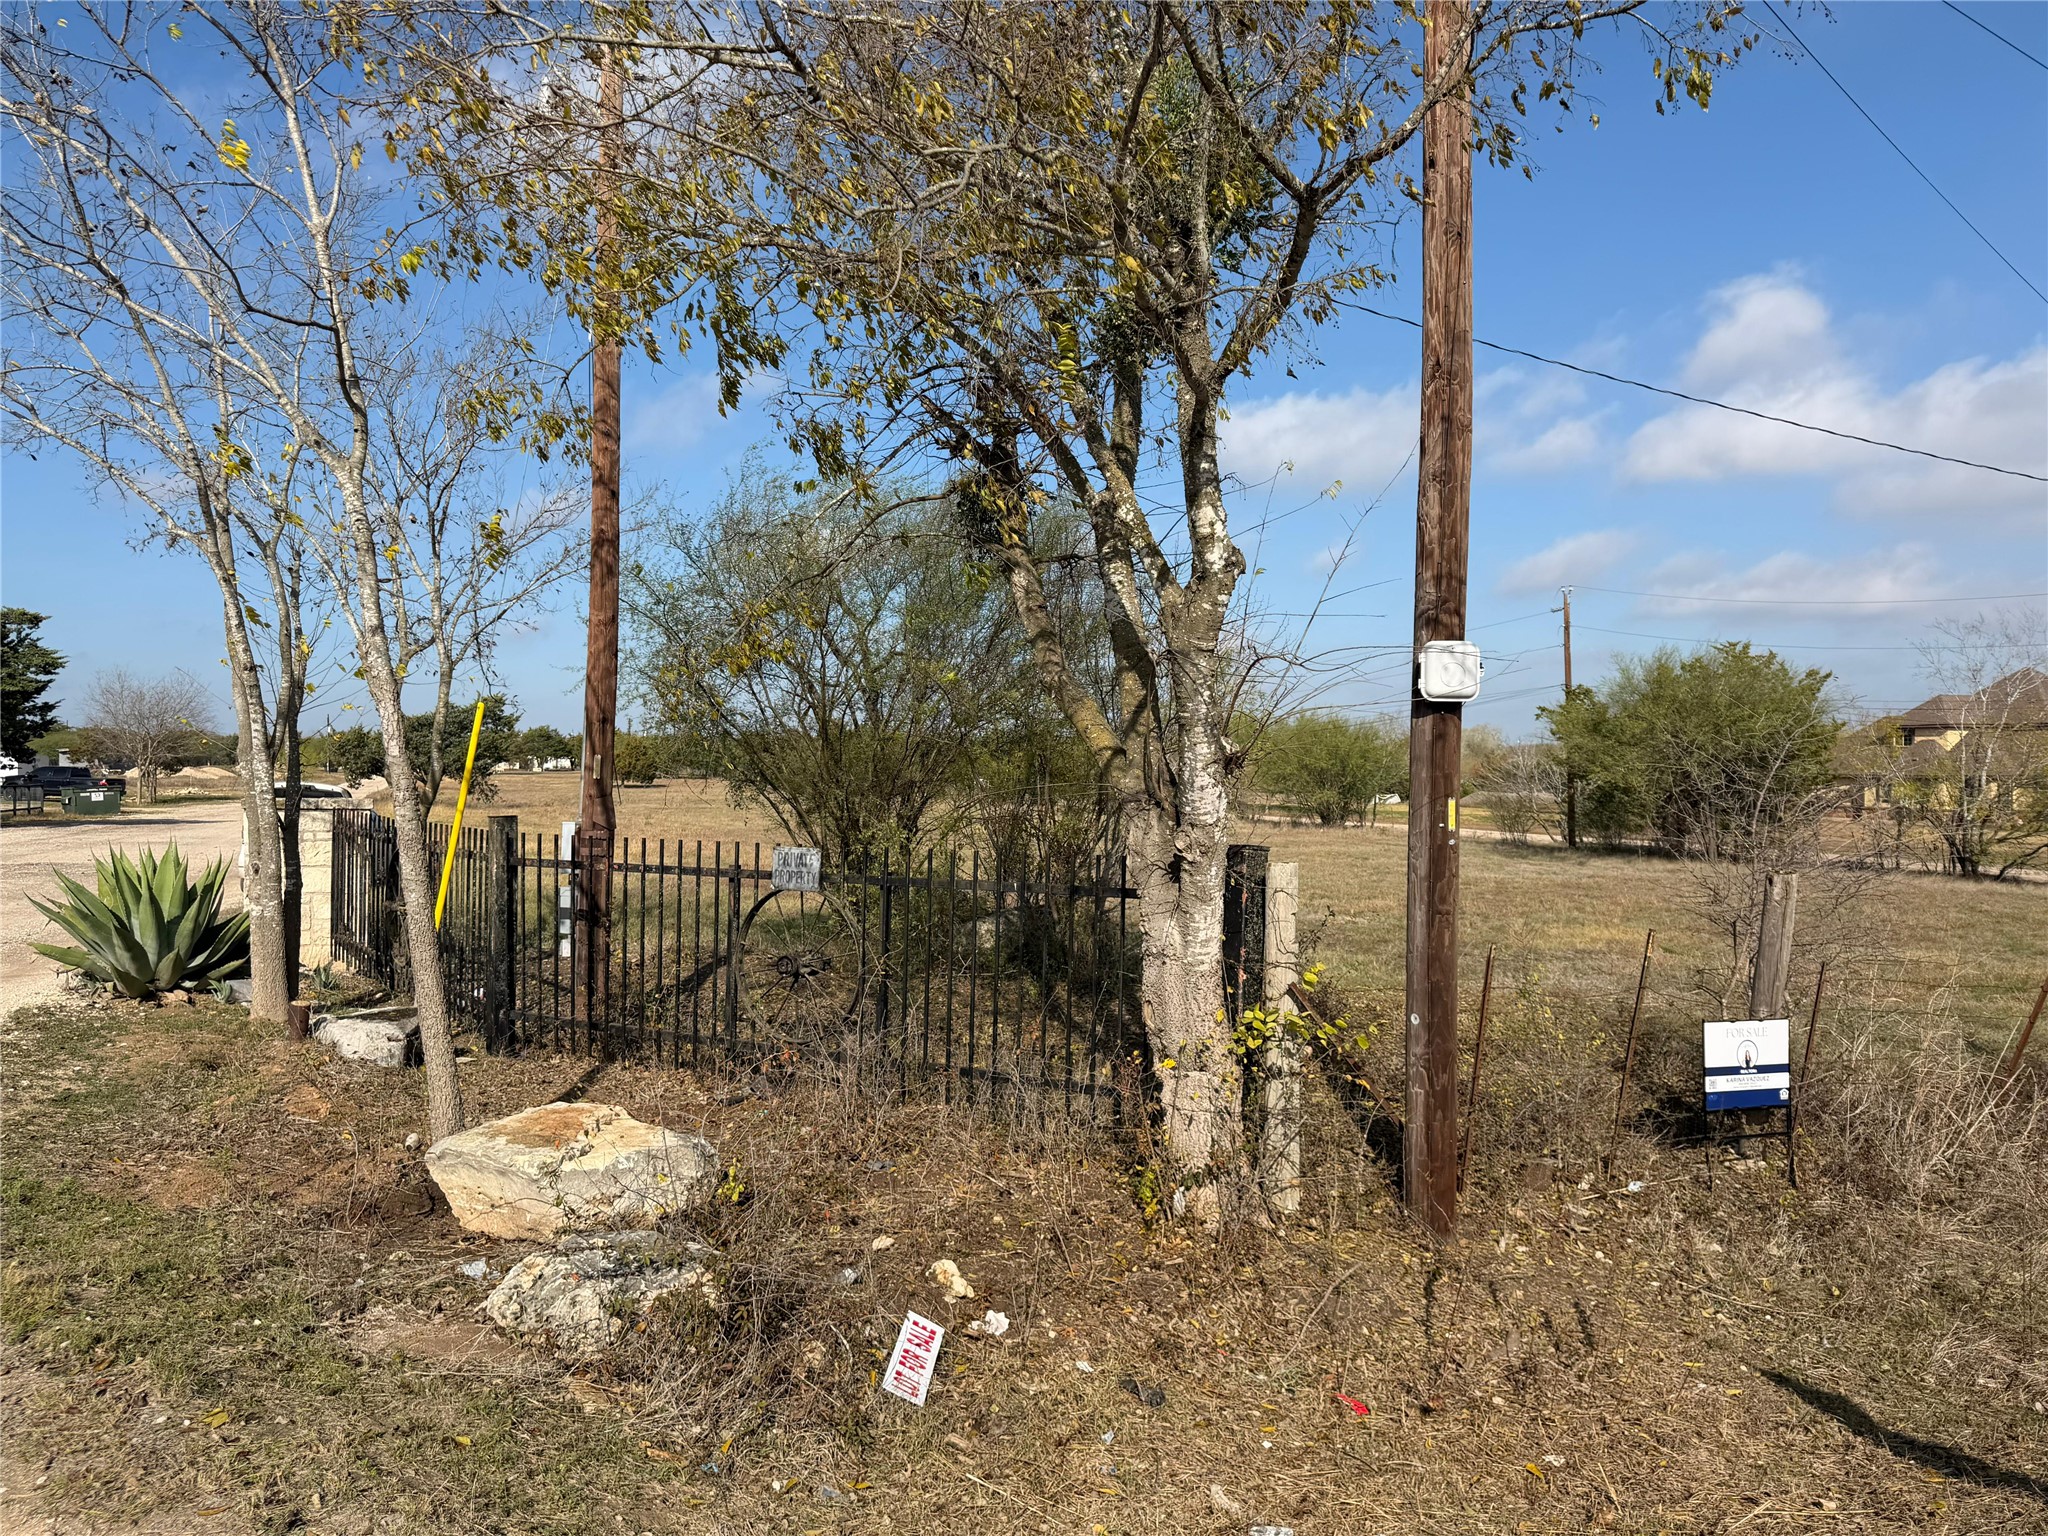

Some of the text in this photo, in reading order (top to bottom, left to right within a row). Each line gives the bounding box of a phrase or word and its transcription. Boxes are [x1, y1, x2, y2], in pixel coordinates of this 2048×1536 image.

[777, 852, 816, 868] PRIVATE
[774, 869, 817, 885] PROPERTY
[1726, 1026, 1768, 1039] FOR SALE
[891, 1320, 937, 1398] LOT FOR SALE
